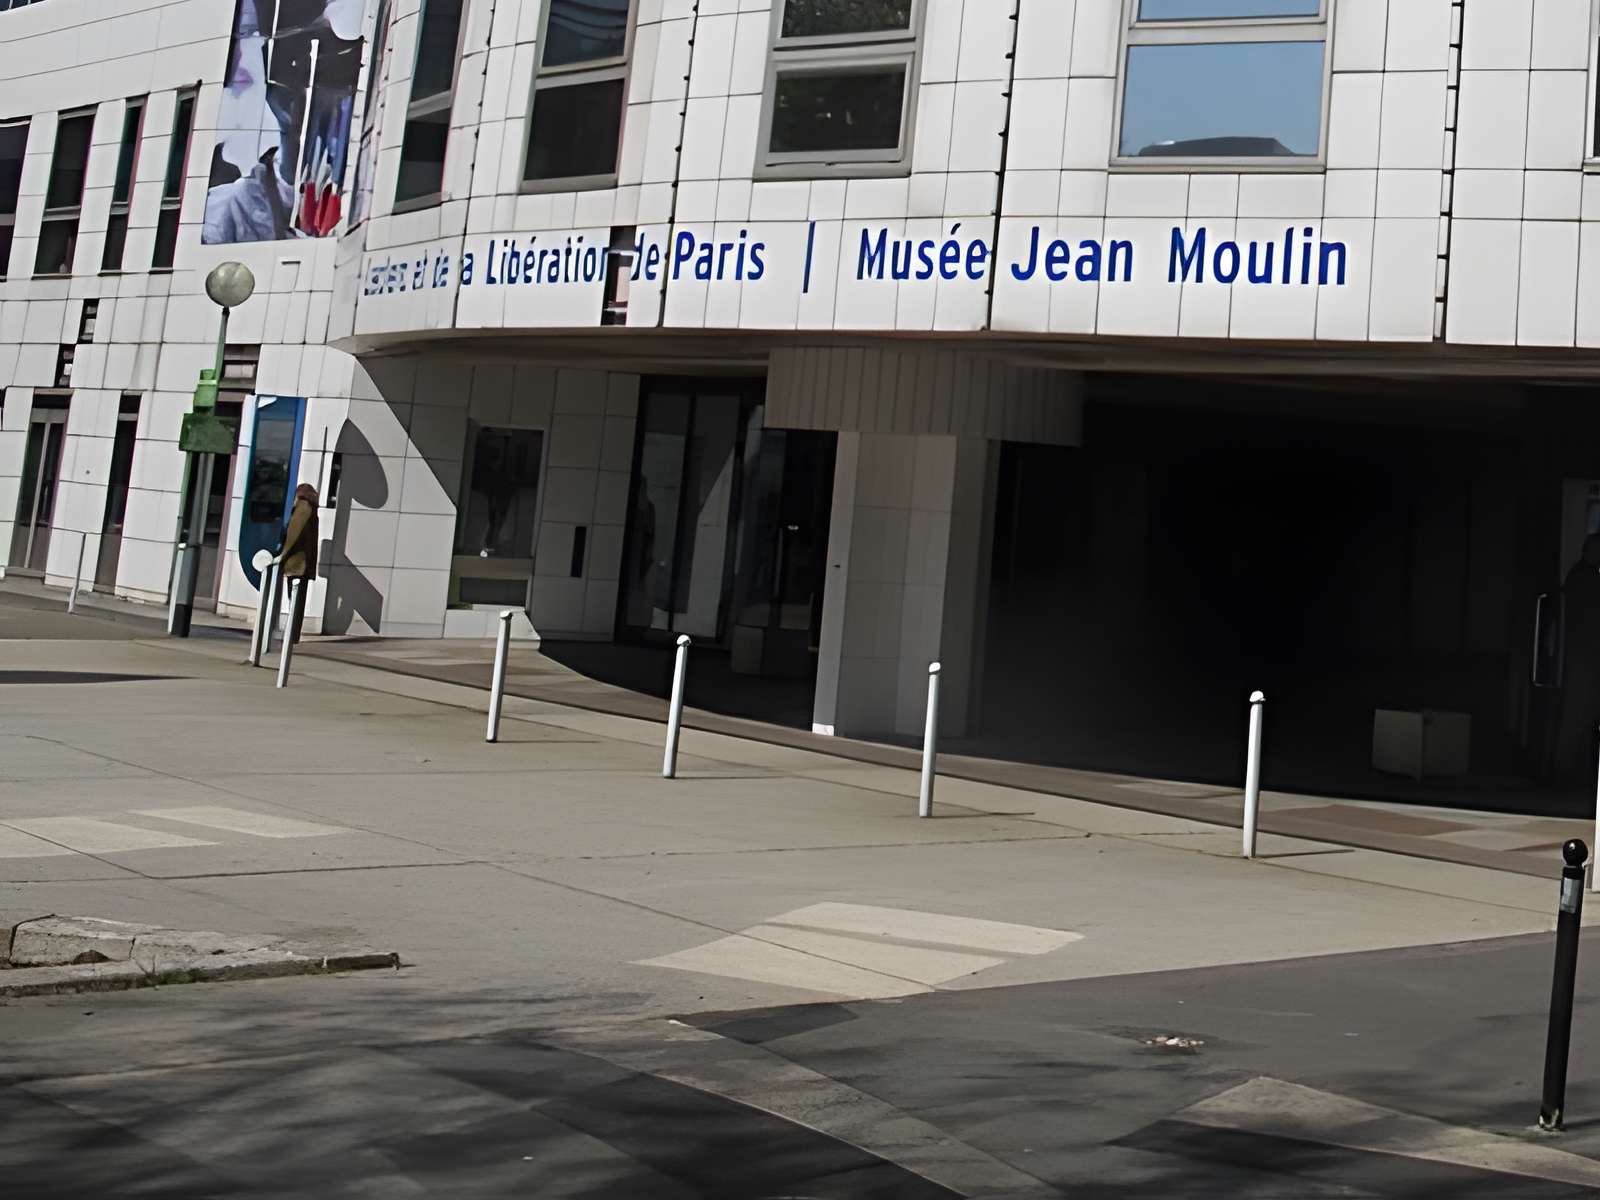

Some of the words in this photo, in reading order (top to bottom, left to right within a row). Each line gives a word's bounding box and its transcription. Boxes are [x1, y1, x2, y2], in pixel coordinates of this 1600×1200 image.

[672, 230, 766, 281] Paris
[857, 223, 988, 281] Musée
[1010, 226, 1134, 283] Jean
[1167, 226, 1347, 286] Moulin
